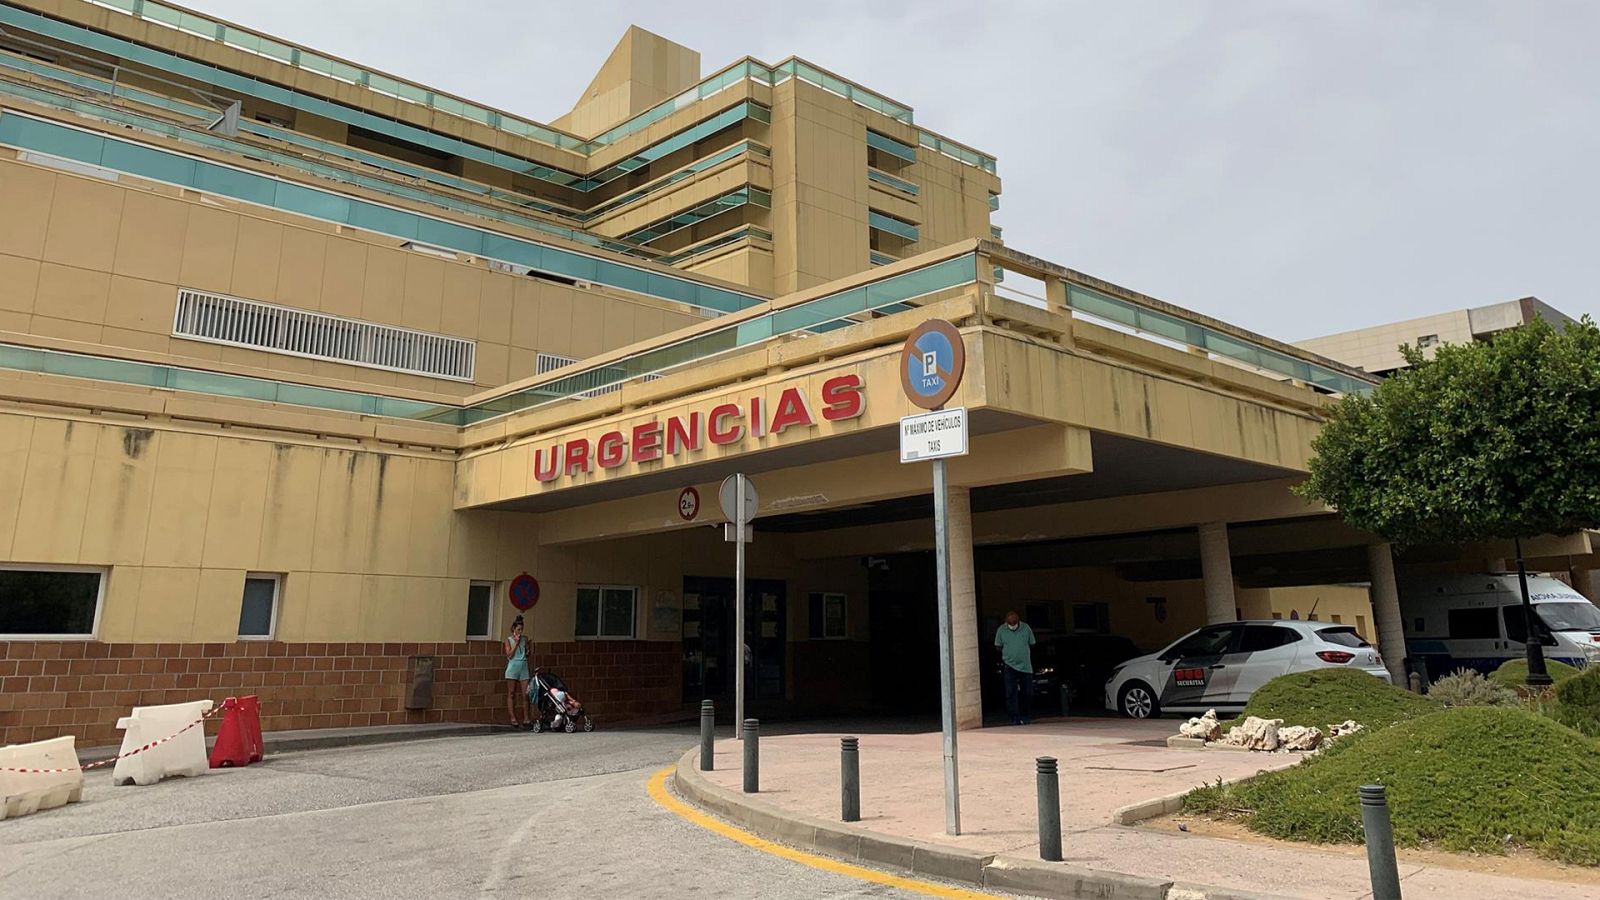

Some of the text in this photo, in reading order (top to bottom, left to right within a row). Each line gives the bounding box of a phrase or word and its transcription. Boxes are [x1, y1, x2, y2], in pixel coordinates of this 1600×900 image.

[925, 355, 934, 374] P
[922, 377, 939, 387] TAXI
[534, 373, 865, 483] URGENCIAS
[928, 420, 935, 433] DE
[928, 440, 941, 452] TAXIS
